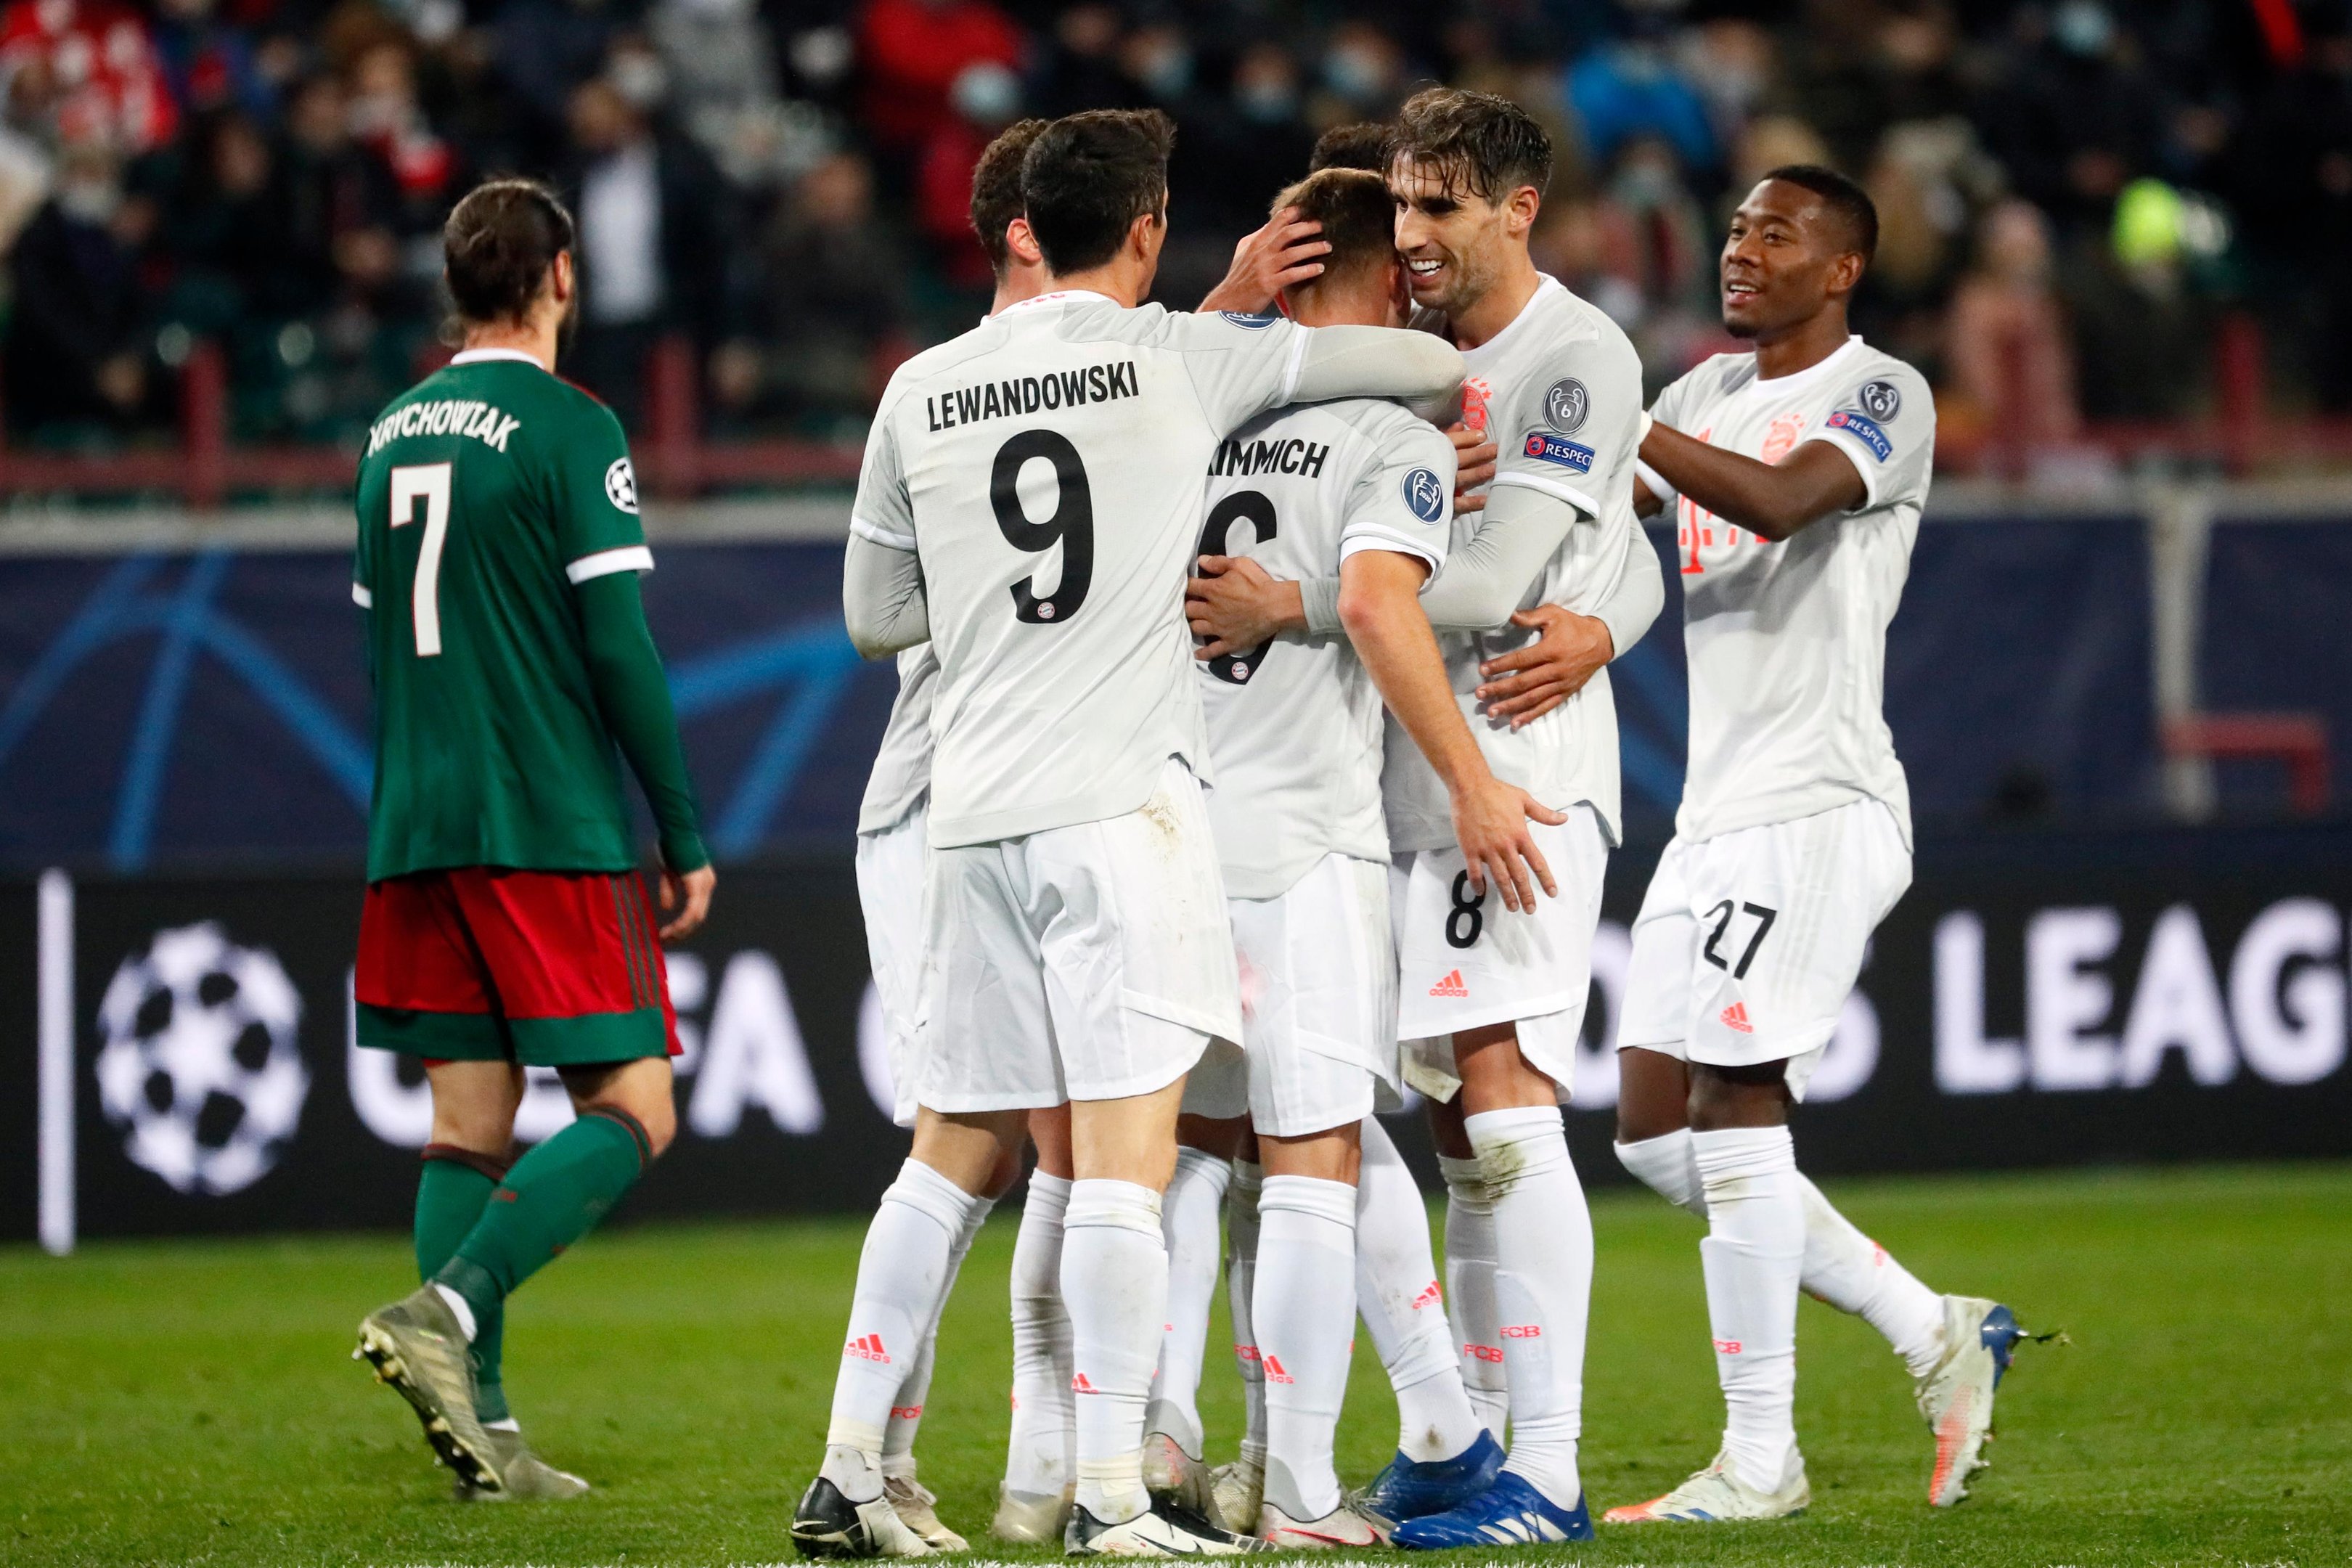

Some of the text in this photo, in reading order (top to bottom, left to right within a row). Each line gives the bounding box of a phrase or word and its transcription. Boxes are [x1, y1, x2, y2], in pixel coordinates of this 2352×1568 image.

[927, 361, 1140, 432] LEWANDOWSKI
[1561, 404, 1572, 418] 6
[1874, 398, 1885, 411] 6
[367, 400, 521, 458] KRYCHOWIAK
[1847, 418, 1890, 457] RESPECT
[1545, 444, 1593, 467] RESPECT
[1418, 489, 1432, 503] 2020
[990, 429, 1095, 624] 9
[390, 462, 452, 656] 7
[1445, 869, 1487, 949] 8
[1702, 899, 1778, 981] 27
[1429, 987, 1469, 998] adidas
[1931, 894, 2352, 1095] LEAG
[1500, 1326, 1541, 1339] FCB
[1463, 1344, 1503, 1363] FCB
